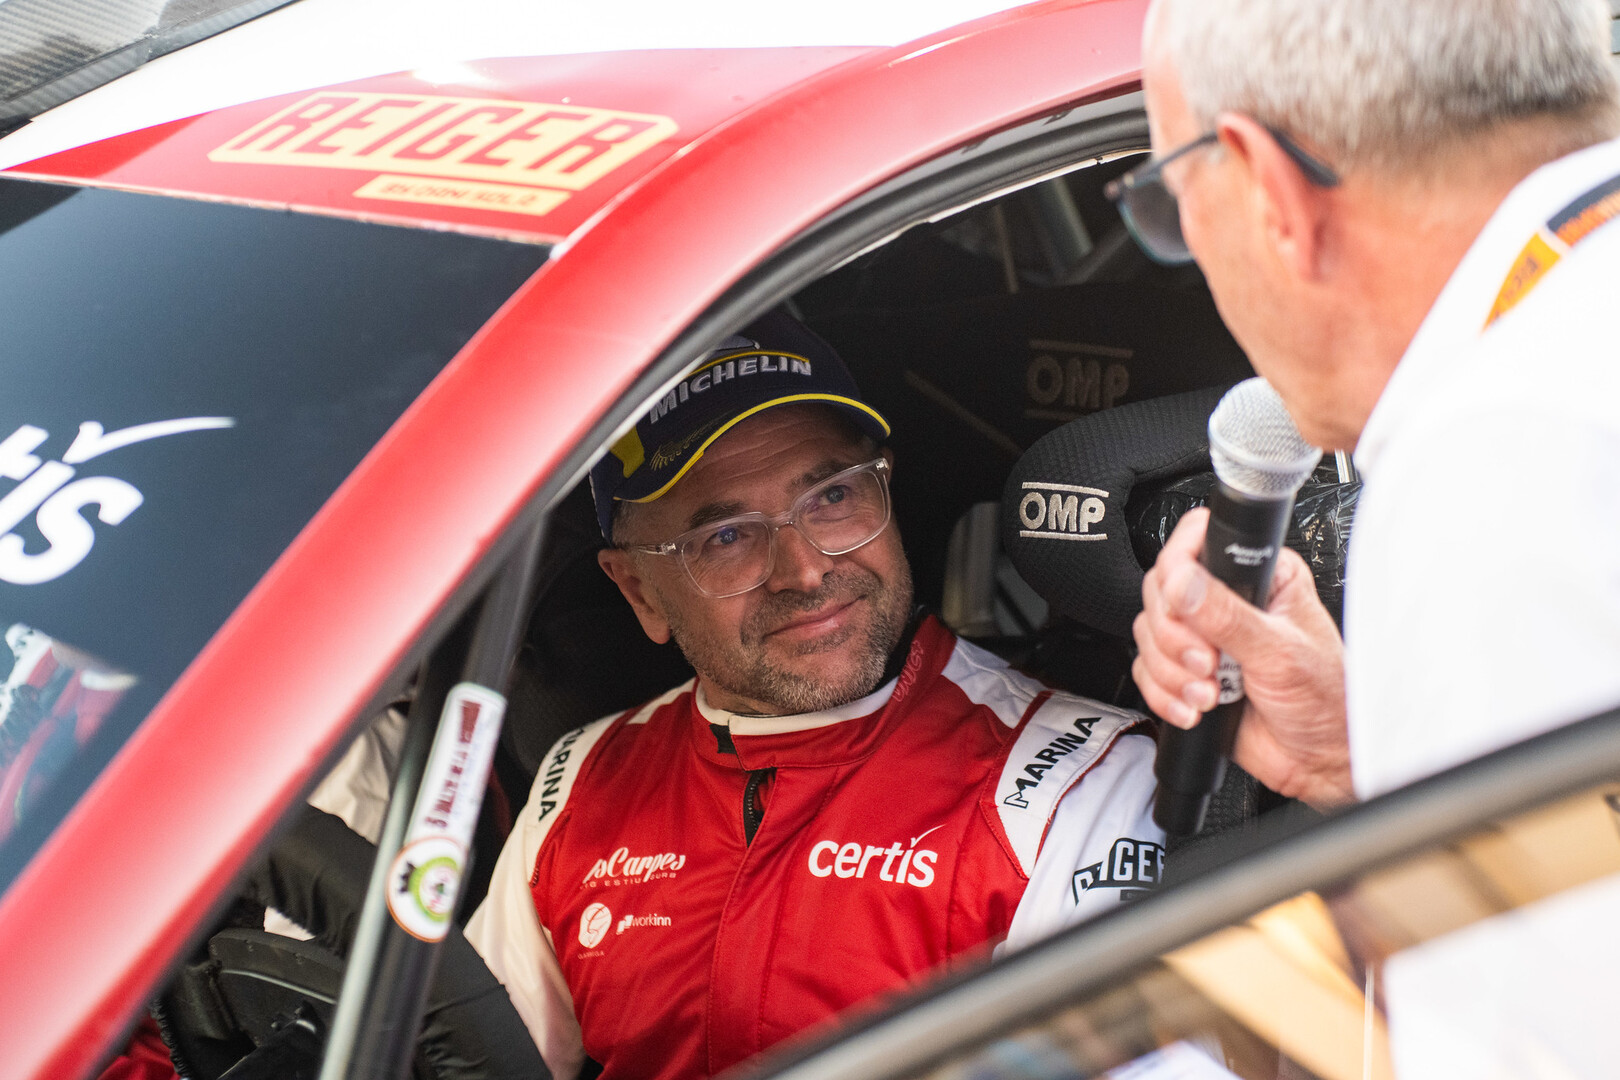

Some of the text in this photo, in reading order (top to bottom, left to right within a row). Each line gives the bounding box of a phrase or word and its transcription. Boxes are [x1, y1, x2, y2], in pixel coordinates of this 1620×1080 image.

[229, 96, 660, 175] REIGER
[650, 355, 812, 424] MICHELIN
[1026, 356, 1130, 409] OMP
[1019, 492, 1106, 533] OMP
[1004, 716, 1101, 809] MARINA
[808, 824, 946, 888] certis
